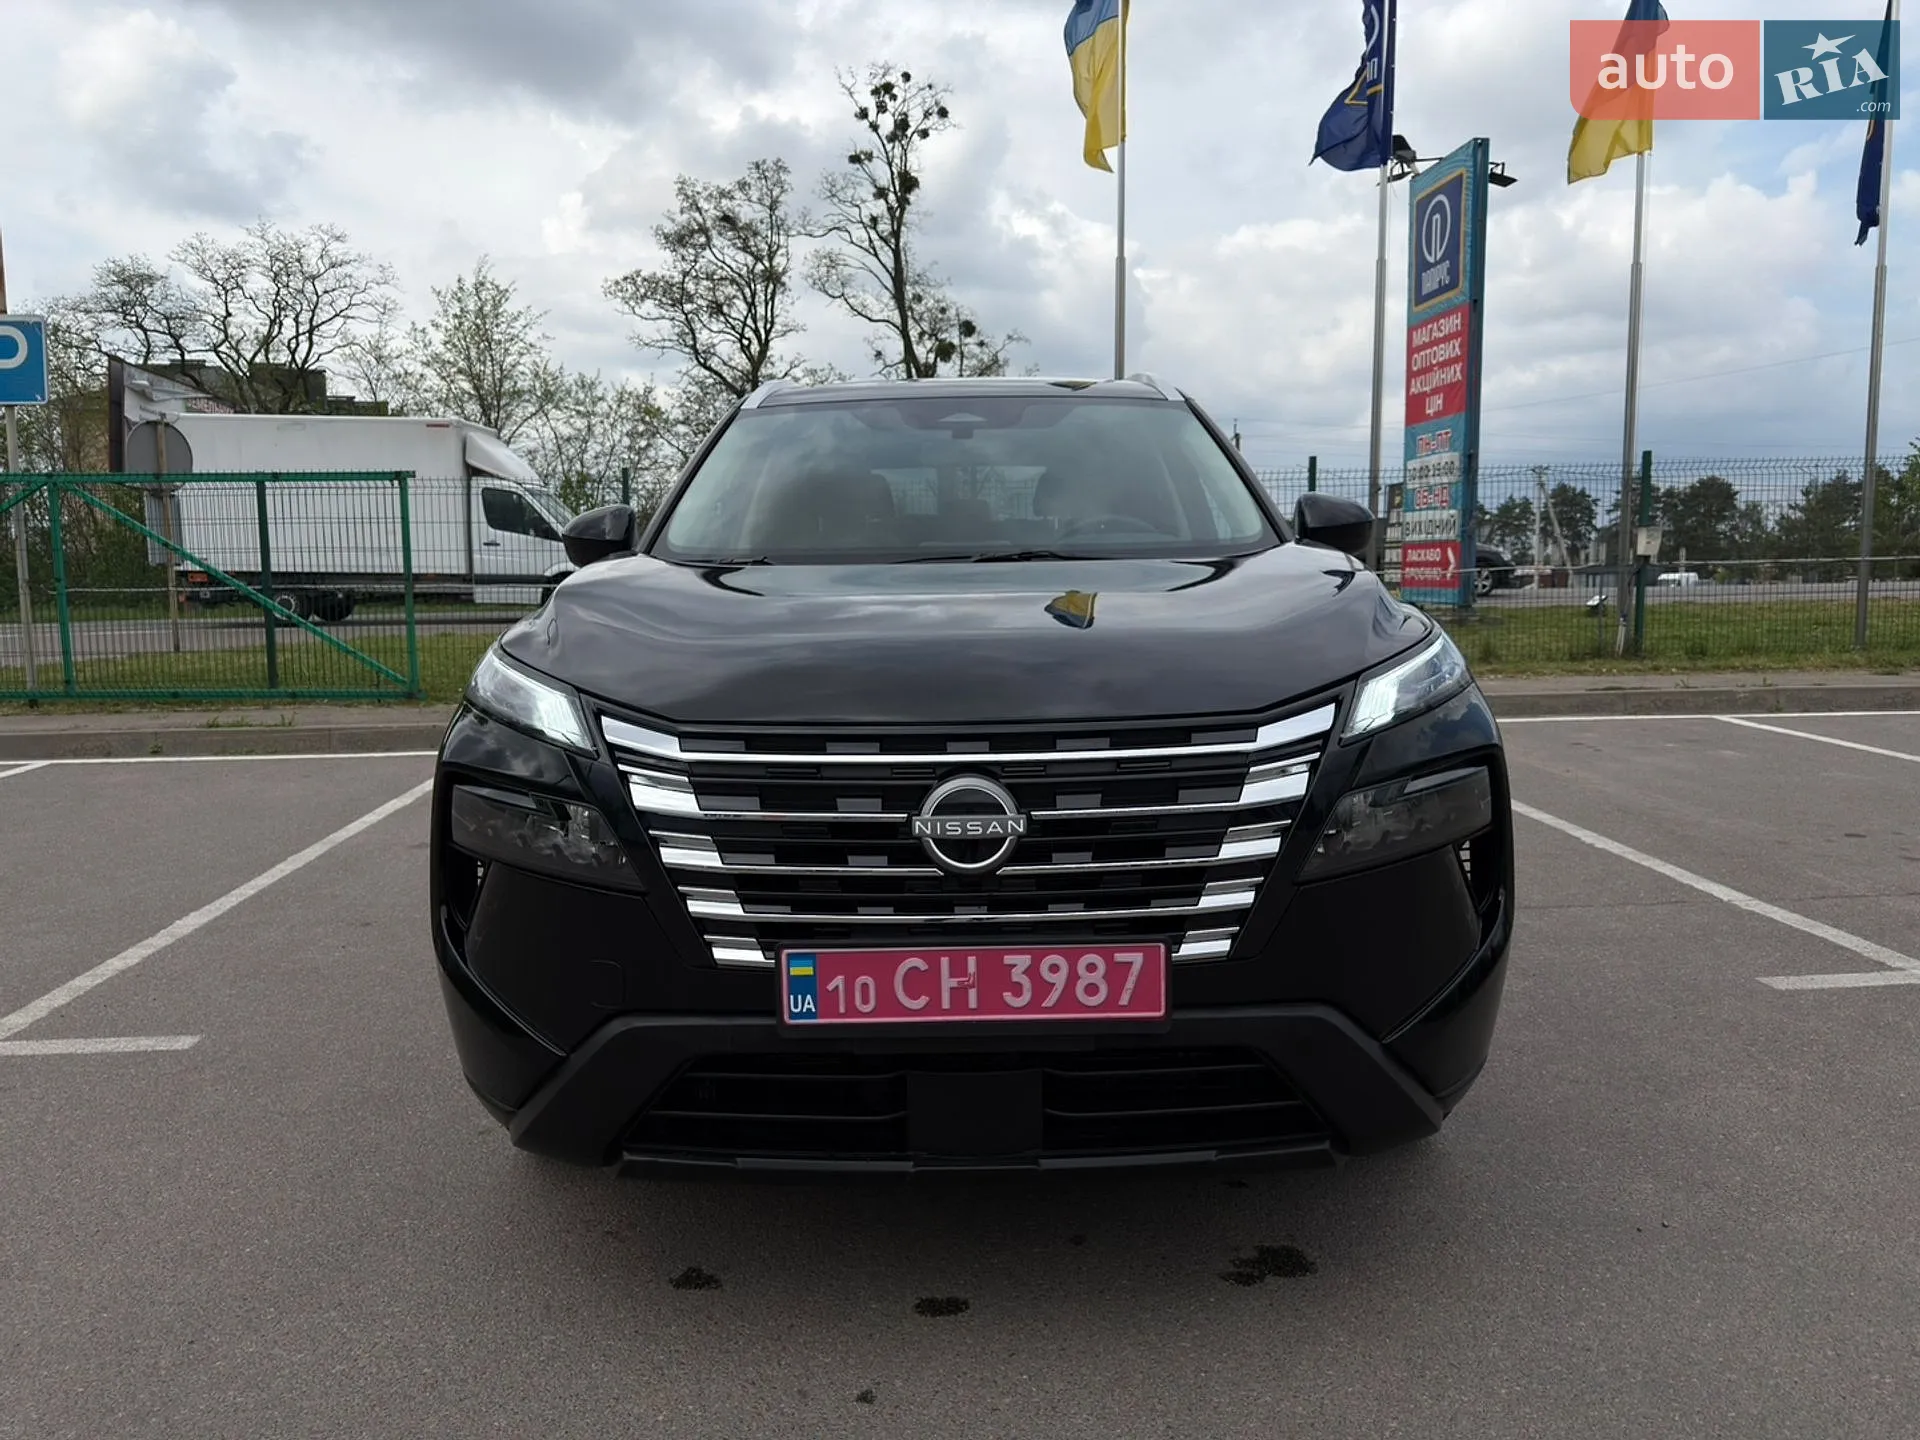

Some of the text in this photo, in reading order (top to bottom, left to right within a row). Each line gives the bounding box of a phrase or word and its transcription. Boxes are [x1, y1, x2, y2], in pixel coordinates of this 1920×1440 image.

[1412, 312, 1462, 348] МАГАЗИН
[1411, 337, 1462, 372] ОПТОВИХ
[1409, 363, 1463, 396] АКЦІЙНИХ
[914, 819, 1025, 836] NISSAN
[826, 974, 877, 1014] 10
[1002, 952, 1145, 1009] 3987
[789, 994, 816, 1013] UA
